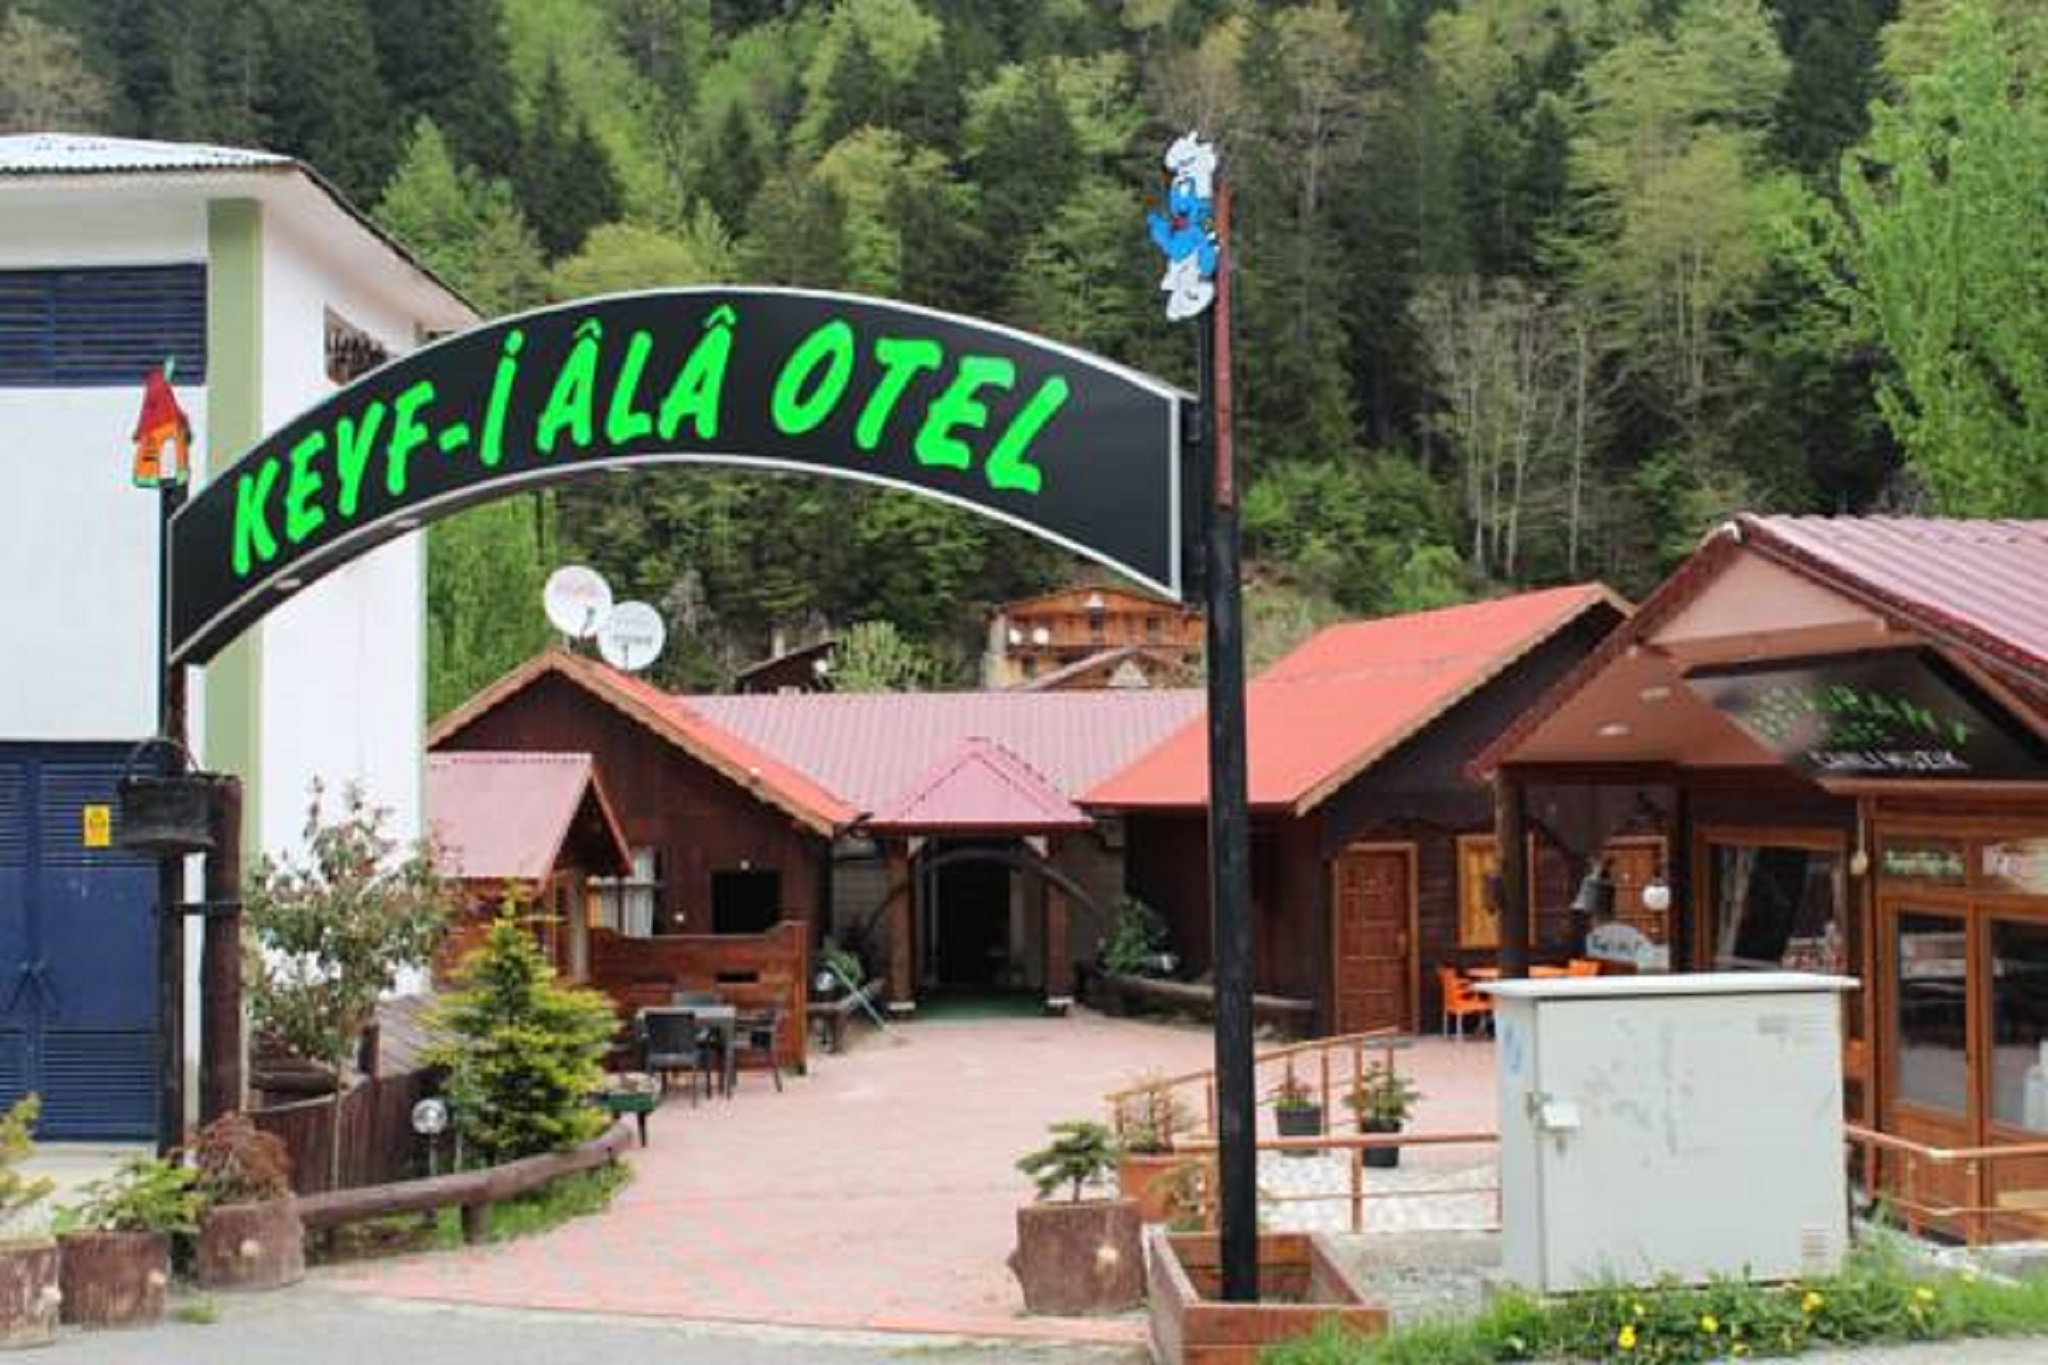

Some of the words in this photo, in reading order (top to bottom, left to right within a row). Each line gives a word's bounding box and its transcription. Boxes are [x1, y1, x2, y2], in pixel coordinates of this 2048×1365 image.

[230, 330, 524, 576] KEYF-İ
[536, 305, 737, 451] ÂLÂ
[772, 320, 1070, 496] OTEL
